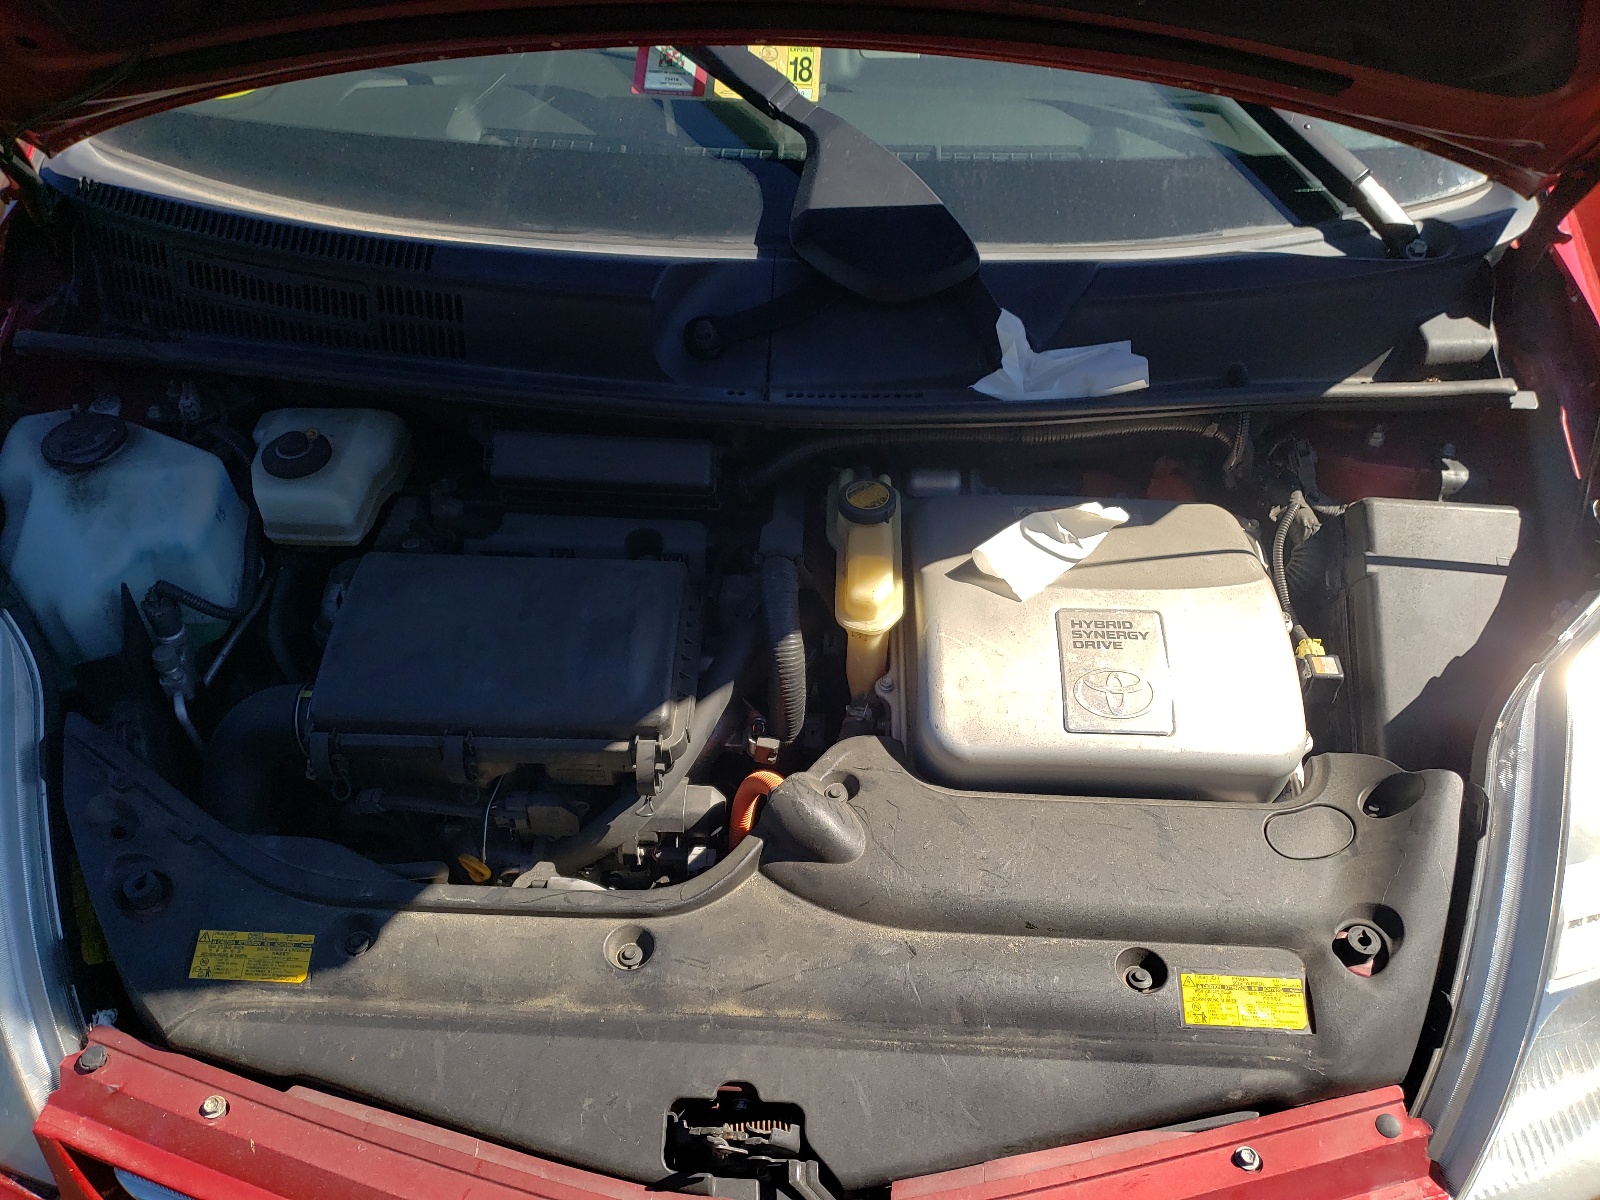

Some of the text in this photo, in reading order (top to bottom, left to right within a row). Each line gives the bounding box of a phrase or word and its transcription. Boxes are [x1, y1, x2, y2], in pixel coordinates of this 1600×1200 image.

[790, 56, 812, 82] 18
[1071, 619, 1133, 630] HYBRID
[1071, 630, 1149, 641] SYNERGY
[1072, 640, 1124, 650] DRIVE
